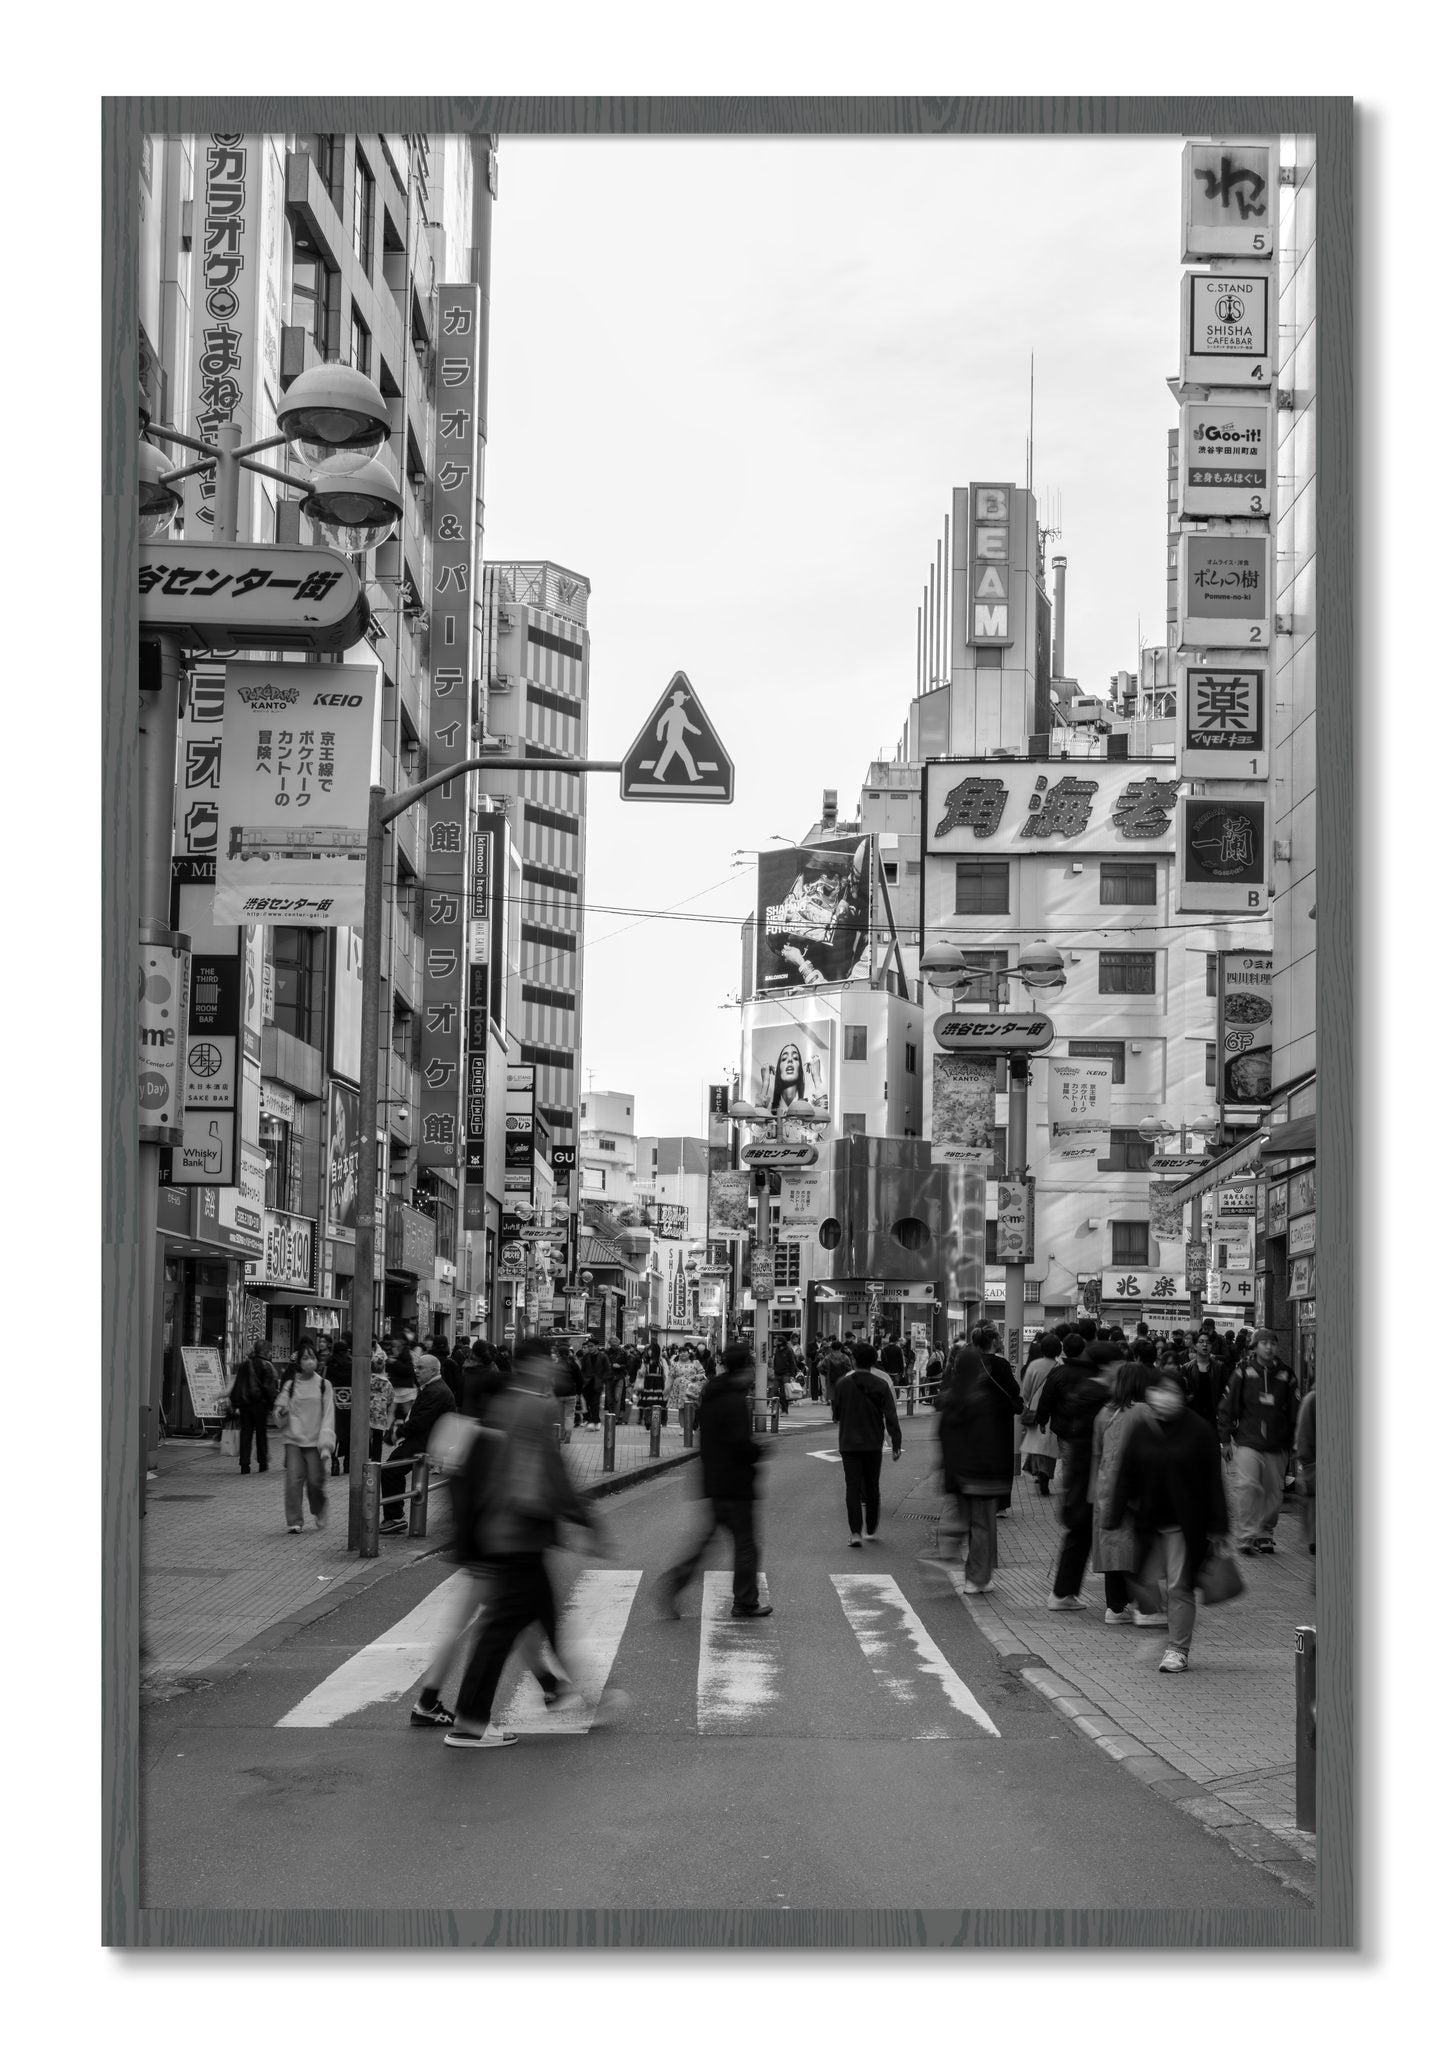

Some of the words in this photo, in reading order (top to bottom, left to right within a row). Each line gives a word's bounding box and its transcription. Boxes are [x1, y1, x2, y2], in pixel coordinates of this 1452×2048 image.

[204, 147, 247, 298] カラオケ
[1252, 234, 1265, 250] 5
[1206, 283, 1253, 293] C.STAND
[1206, 325, 1253, 336] SHISHA
[1206, 336, 1253, 345] CAFE&BAR
[1205, 425, 1262, 442] Goo-it!
[1198, 446, 1258, 455] 渋谷宇田川町店
[1192, 472, 1262, 484] 全身もみほぐし
[1250, 495, 1263, 512] 3
[976, 488, 1009, 638] BEAM
[1250, 626, 1262, 642] 2
[313, 693, 363, 707] KEIO
[1197, 676, 1249, 729] 薬
[1191, 732, 1255, 747] マツモトキヨシ
[255, 730, 273, 774] 冒険へ
[274, 730, 293, 807] カントーの
[318, 731, 336, 793] 京王線で
[1249, 758, 1258, 774] 1
[934, 776, 1179, 838] 角海老
[477, 837, 486, 873] kimono
[243, 898, 334, 911] 渋谷センター街
[476, 879, 485, 914] hearts
[1248, 890, 1260, 907] B
[941, 1022, 1047, 1036] 渋谷センター街
[1225, 1031, 1254, 1051] 6F
[147, 1082, 167, 1096] Day!
[184, 1148, 218, 1159] Whisky
[554, 1152, 574, 1163] GU
[745, 1149, 808, 1158] 渋谷センター街
[183, 1159, 203, 1167] Bank
[1152, 1159, 1211, 1168] 渋谷センター街
[1116, 1274, 1177, 1297] 兆楽
[675, 1273, 685, 1317] BEER
